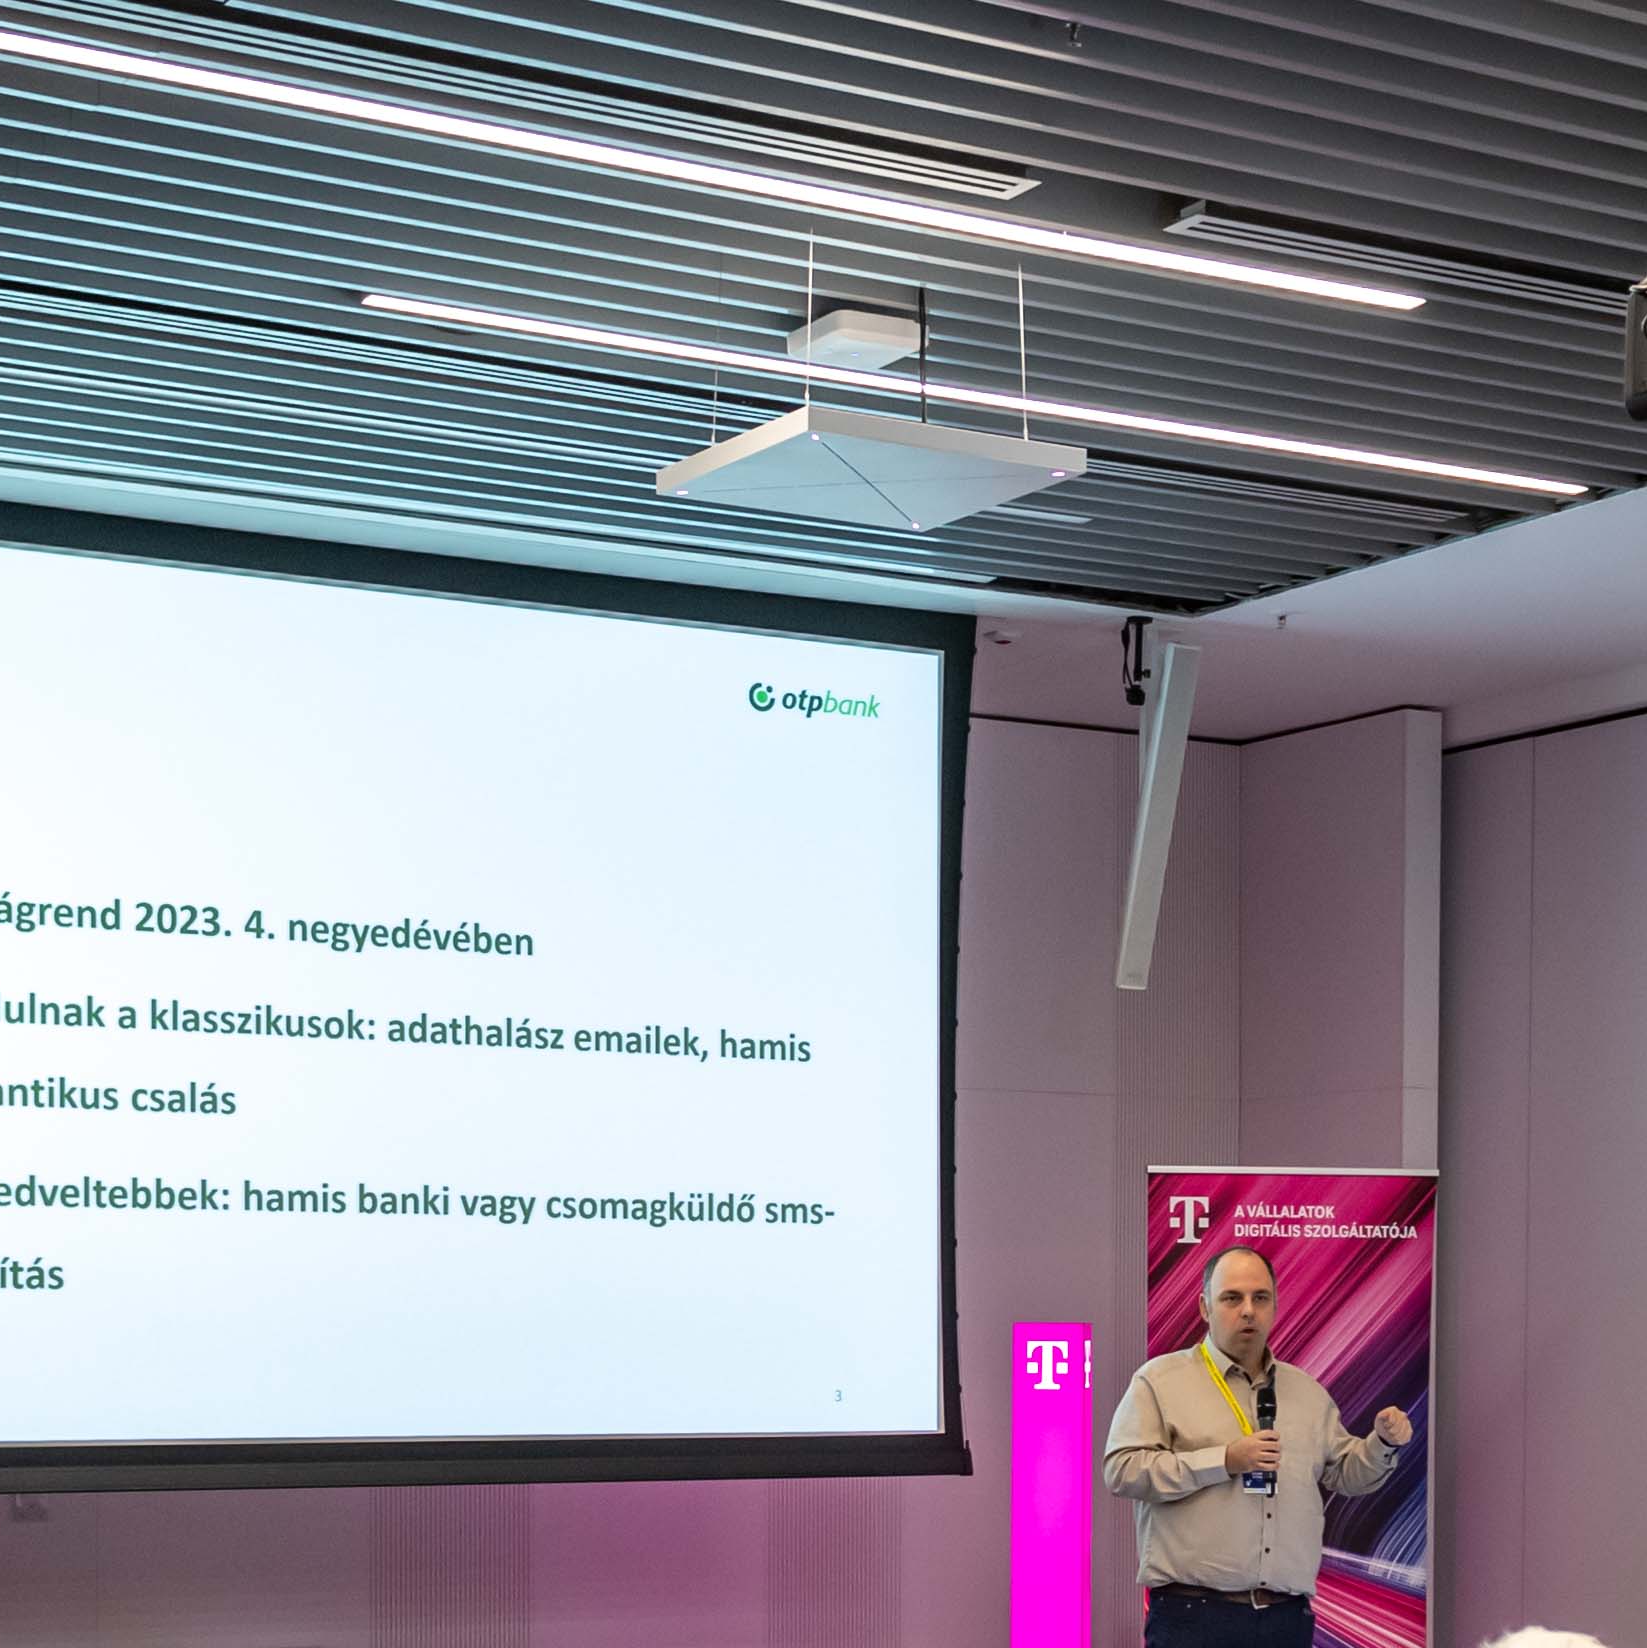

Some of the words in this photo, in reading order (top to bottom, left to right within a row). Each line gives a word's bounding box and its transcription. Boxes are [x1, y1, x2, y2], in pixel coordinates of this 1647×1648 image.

[781, 688, 881, 719] otpbank
[135, 901, 232, 937] 2023.
[243, 909, 276, 941] 4.
[288, 917, 534, 957] negyedévében
[117, 1005, 137, 1030] a
[150, 998, 376, 1041] klasszikusok:
[387, 1012, 565, 1050] adathalász
[573, 1024, 709, 1063] emailek,
[719, 1028, 812, 1063] hamis
[131, 1081, 237, 1116] csalás
[243, 1179, 347, 1214] hamis
[358, 1182, 450, 1216] banki
[459, 1194, 537, 1225] vagy
[545, 1191, 756, 1229] csomagküldő
[764, 1202, 836, 1225] sms-
[1234, 1205, 1245, 1218] A
[1248, 1201, 1335, 1219] VÁLLALATOK
[1234, 1221, 1301, 1238] DIGITÁLIS
[1303, 1221, 1418, 1239] SZOLGÁLTATÓJA
[1026, 1340, 1068, 1390] T
